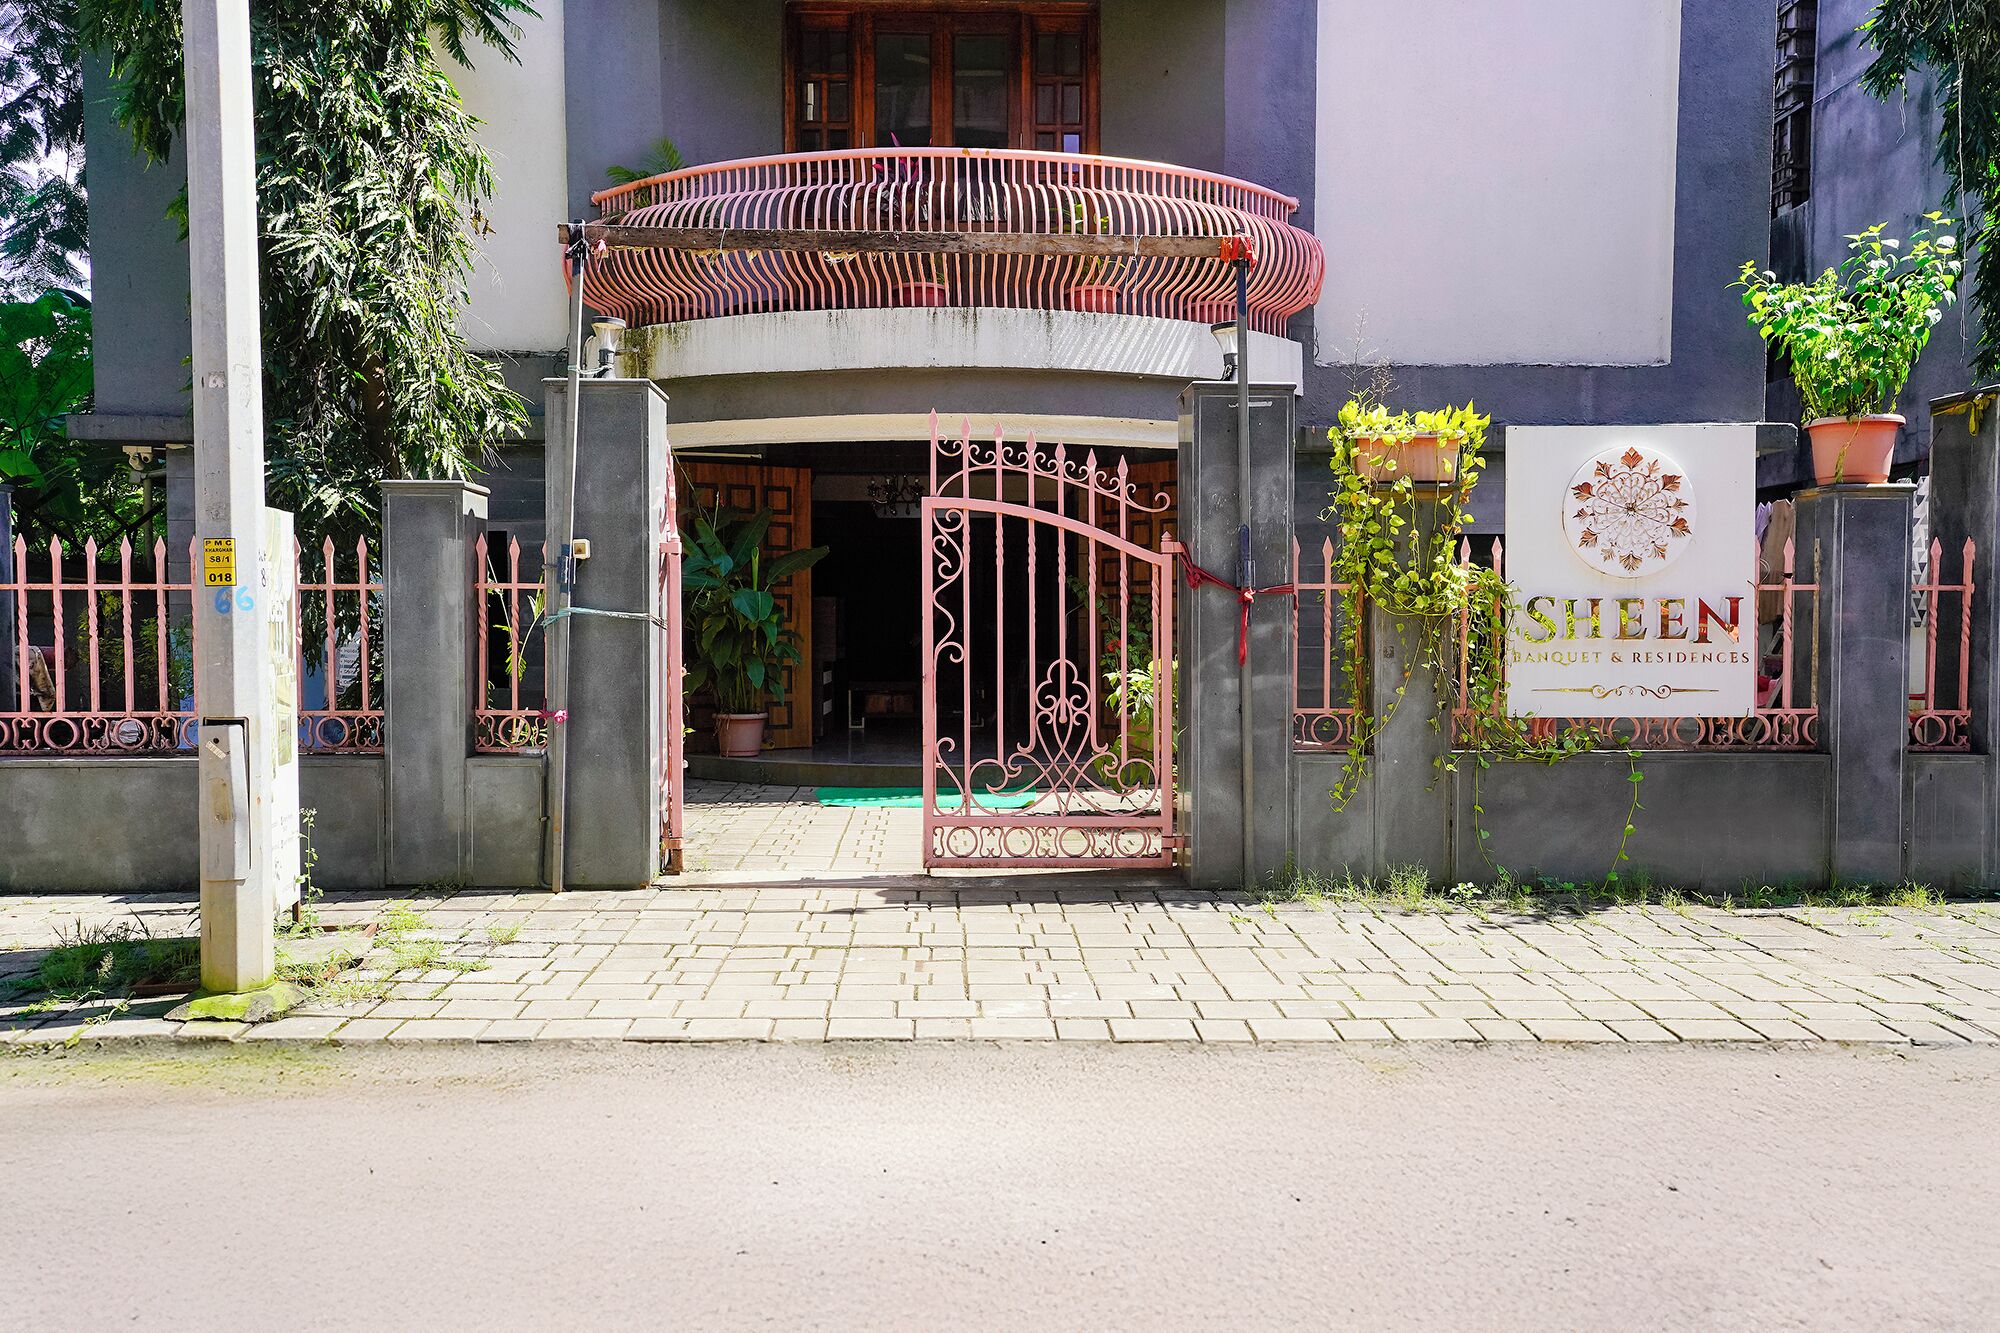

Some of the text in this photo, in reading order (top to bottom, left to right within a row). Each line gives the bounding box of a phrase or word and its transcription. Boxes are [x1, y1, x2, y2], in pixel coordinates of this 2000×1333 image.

[209, 555, 230, 563] S8/1
[208, 573, 232, 582] 018
[1522, 596, 1745, 645] SHEEN
[1513, 651, 1750, 667] BANQUET & RESIDENCES
